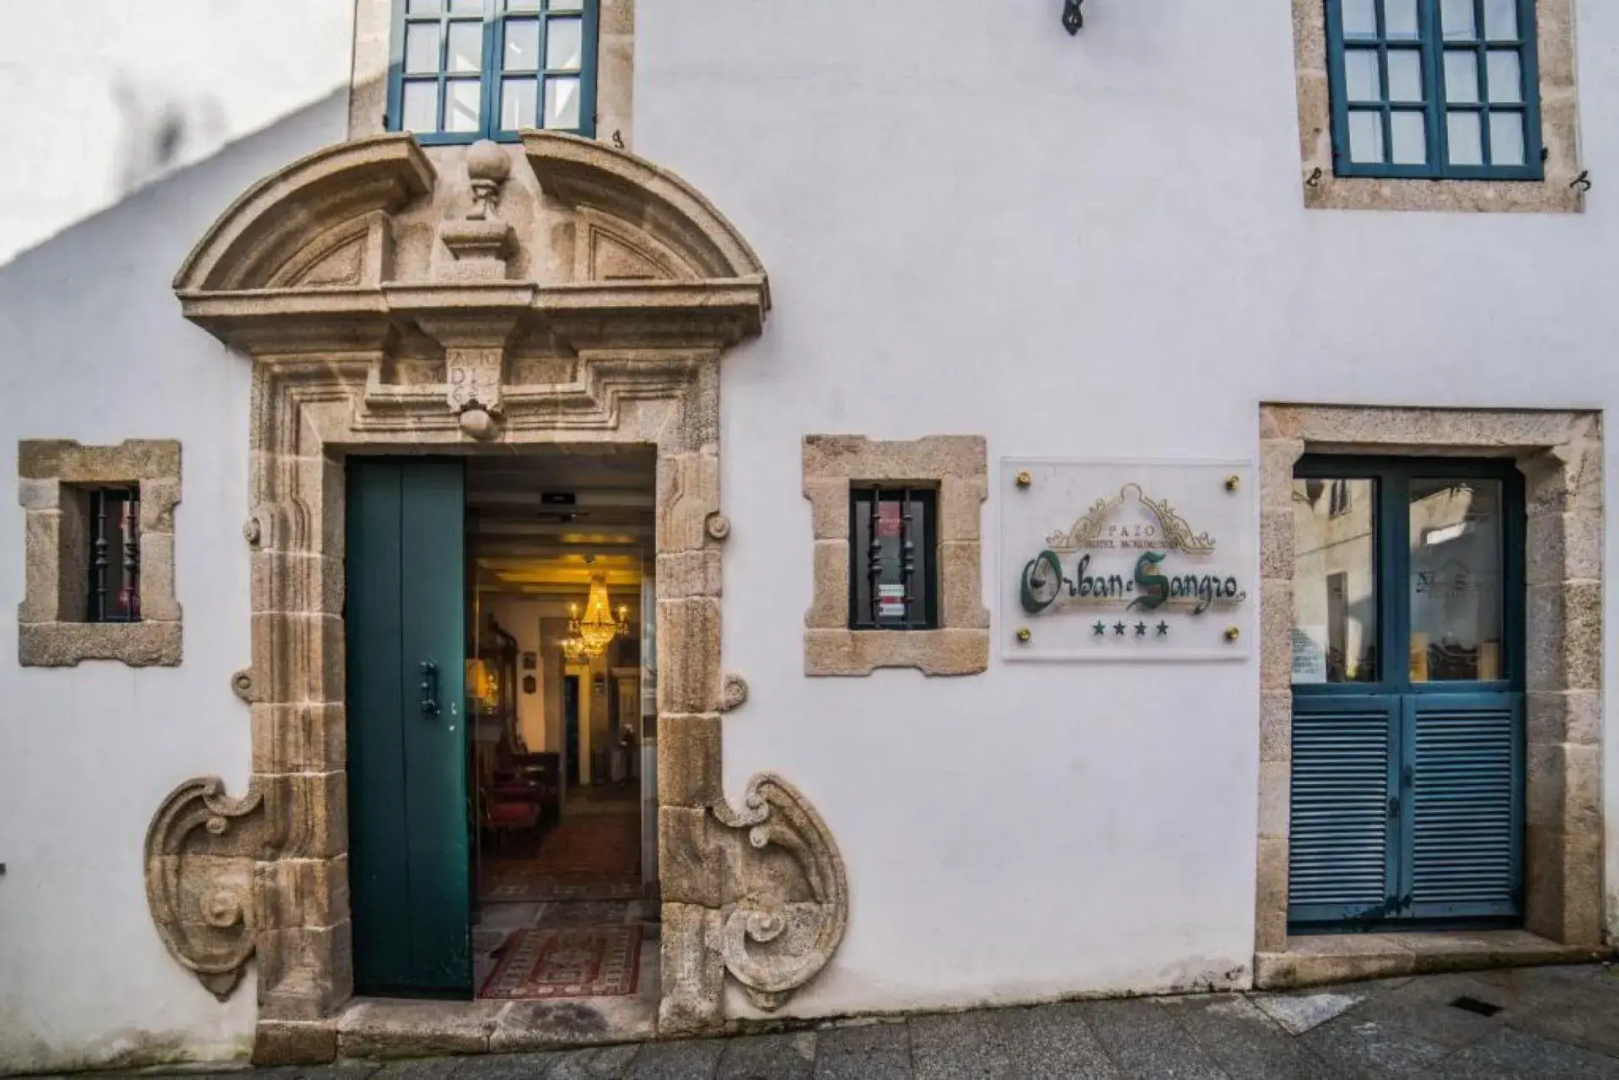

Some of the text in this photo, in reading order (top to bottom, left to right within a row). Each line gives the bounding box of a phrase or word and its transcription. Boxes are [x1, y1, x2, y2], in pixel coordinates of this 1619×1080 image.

[1108, 525, 1155, 537] PAZO
[1020, 550, 1123, 614] Orban
[1126, 551, 1238, 615] Sangro
